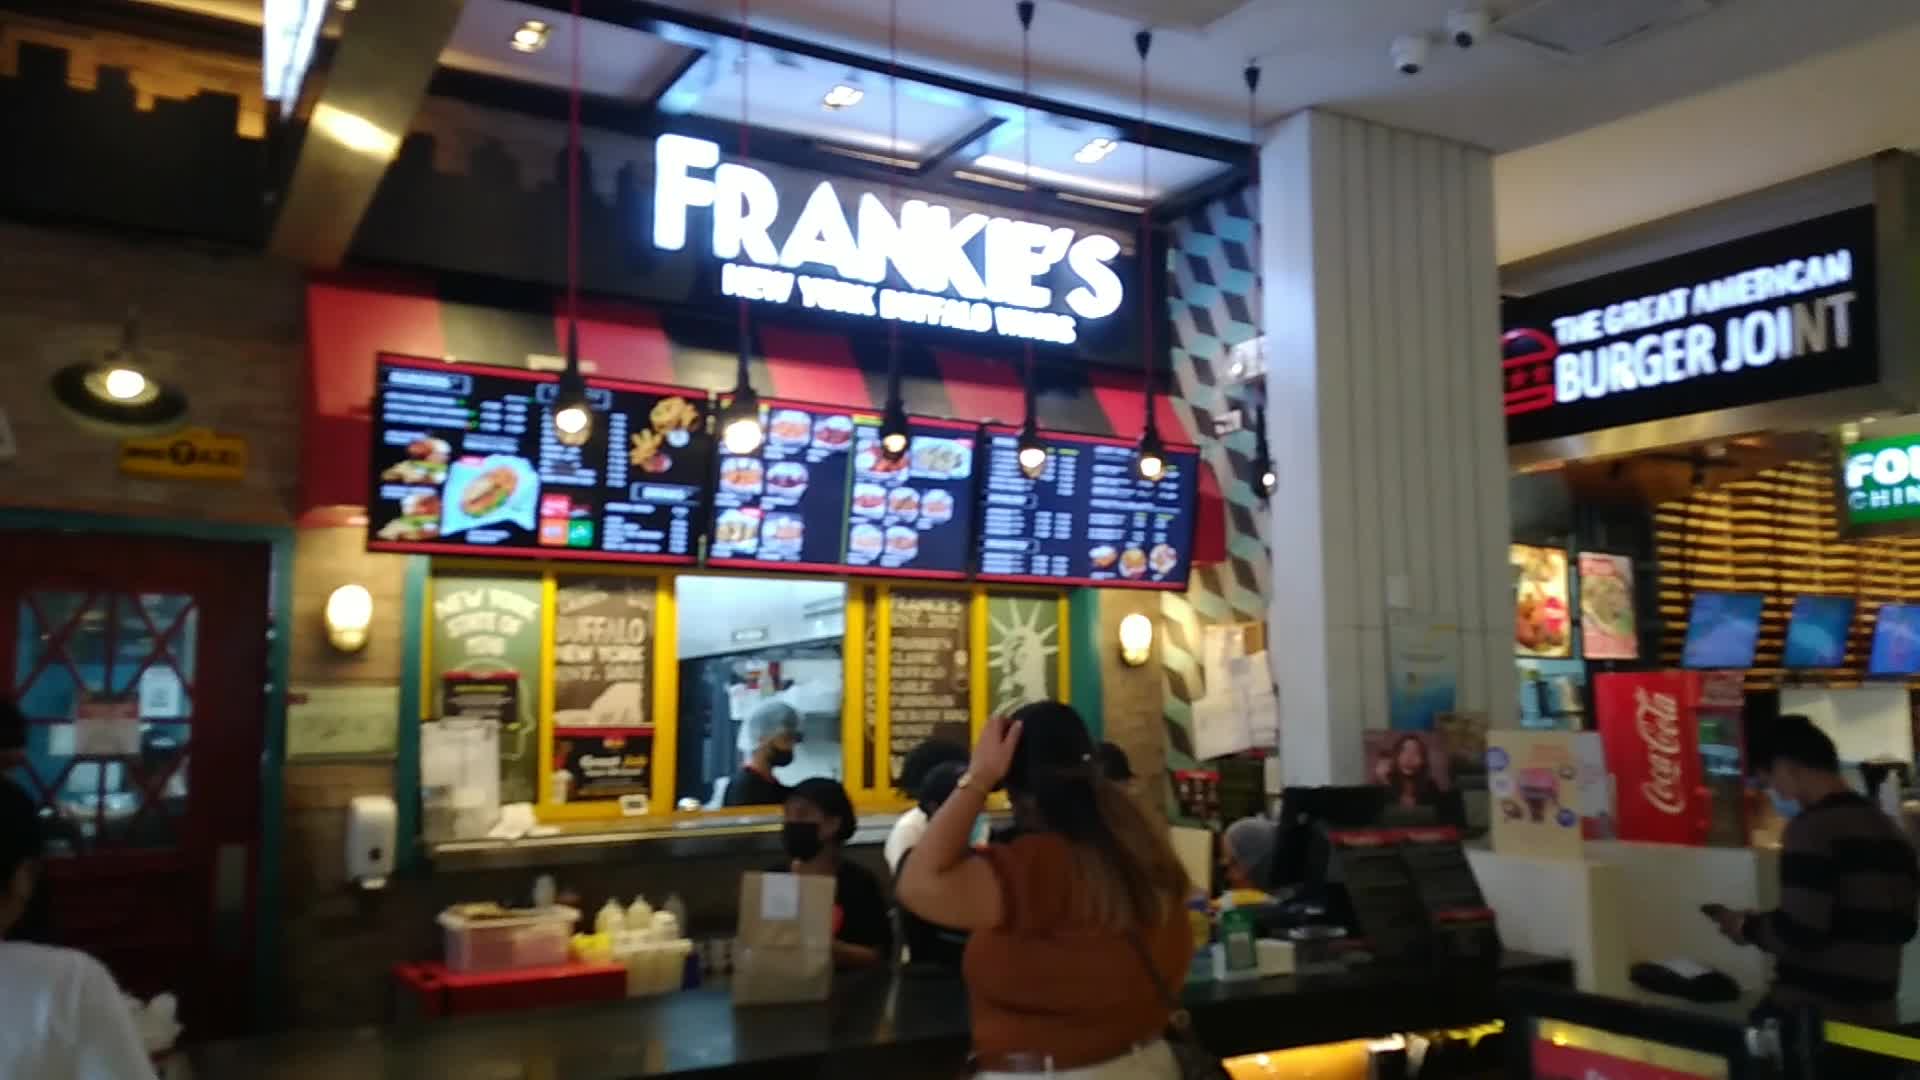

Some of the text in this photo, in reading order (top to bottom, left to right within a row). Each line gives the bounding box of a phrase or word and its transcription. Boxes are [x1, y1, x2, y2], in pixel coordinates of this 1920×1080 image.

[653, 133, 1123, 319] FRANKIE'S
[721, 262, 796, 304] NEW
[797, 275, 877, 316] YORK
[879, 288, 993, 332] BUFFALO
[1553, 248, 1853, 345] THE GREAT AMERICAN
[1553, 291, 1856, 403] BURGER JOINT
[1635, 685, 1686, 814] Coca-Cola
